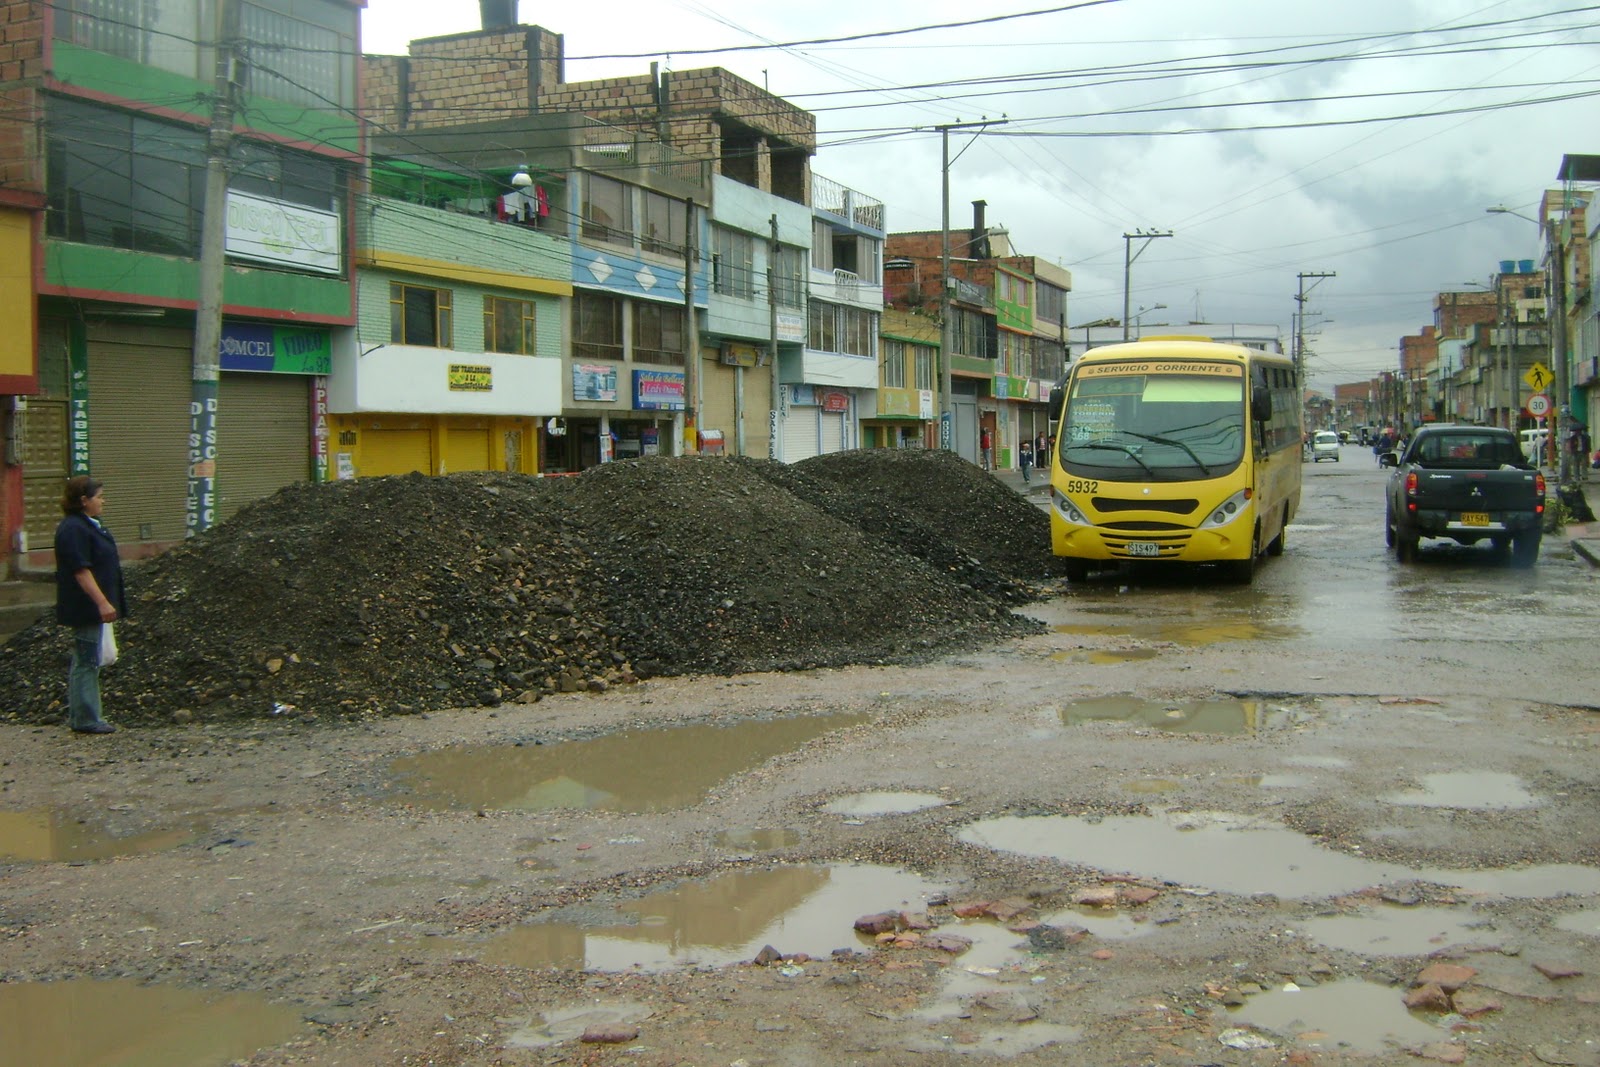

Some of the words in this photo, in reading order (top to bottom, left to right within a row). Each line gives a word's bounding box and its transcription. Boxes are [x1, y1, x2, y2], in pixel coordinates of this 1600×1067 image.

[219, 336, 274, 357] COMCEL
[1097, 365, 1149, 374] SERVICIO
[1155, 364, 1222, 373] CORRIENTE
[1533, 401, 1544, 410] 30
[74, 399, 88, 471] TABERNA
[1067, 480, 1098, 494] 5932
